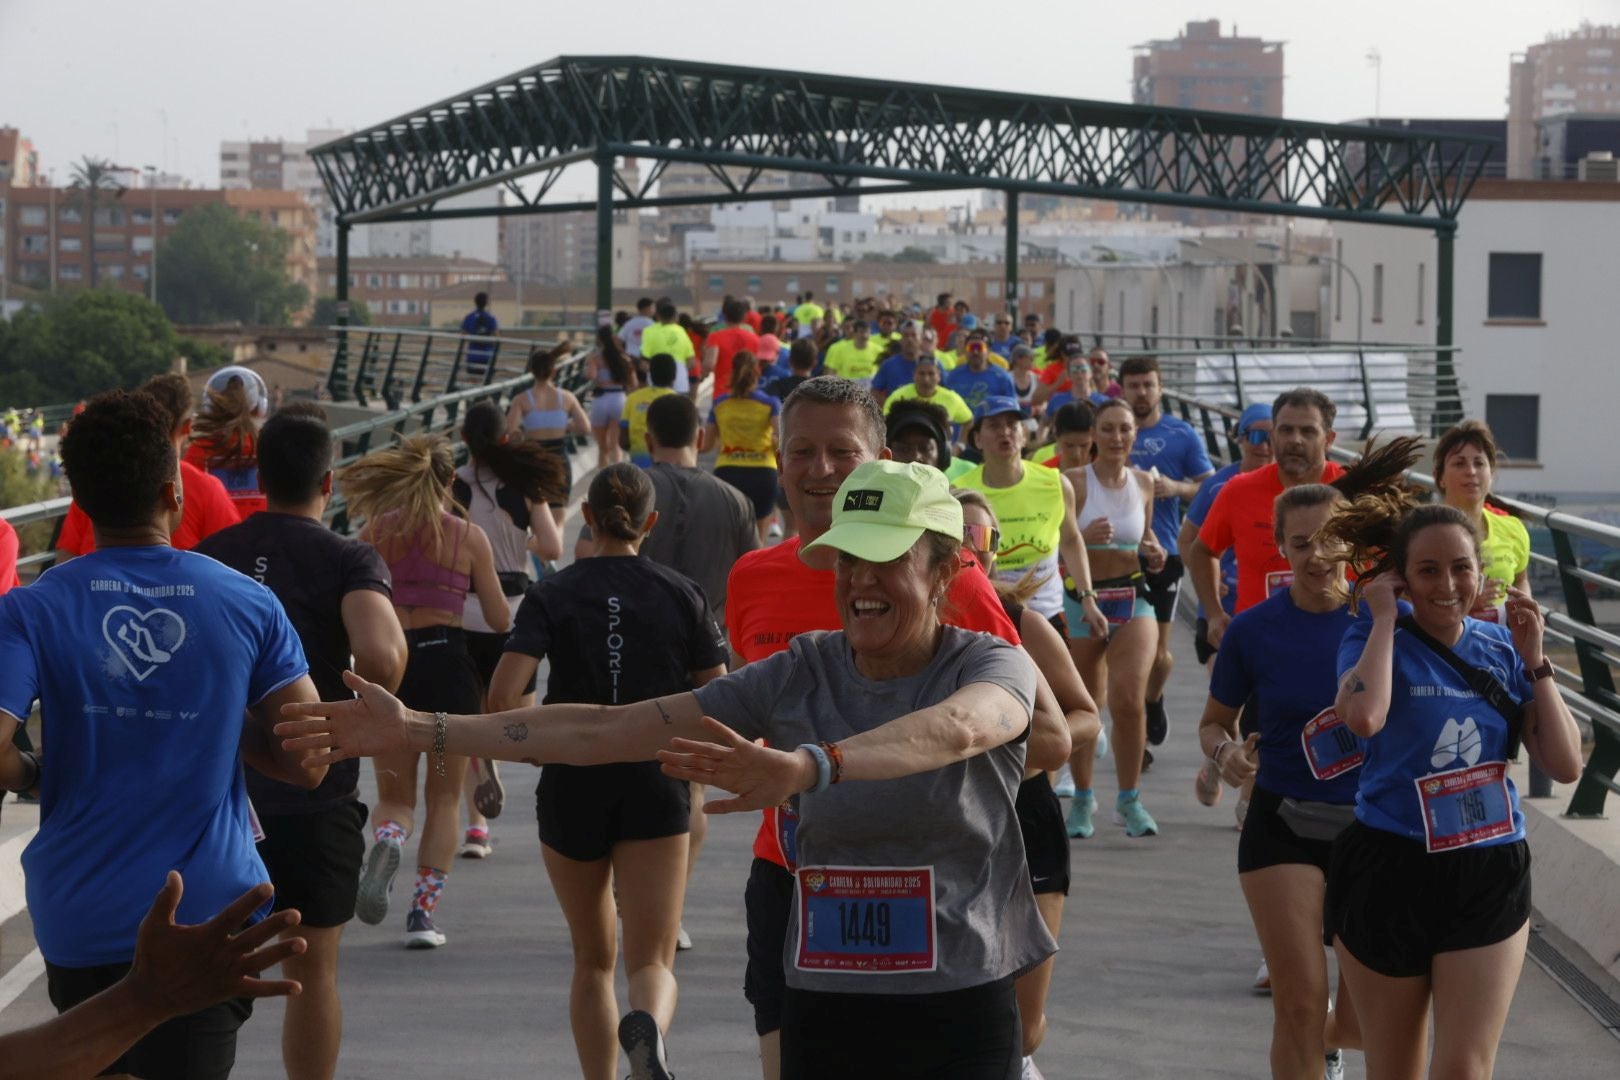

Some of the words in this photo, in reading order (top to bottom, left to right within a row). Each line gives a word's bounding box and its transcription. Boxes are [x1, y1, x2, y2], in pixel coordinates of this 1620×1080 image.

[90, 579, 121, 592] CARRERA
[176, 585, 195, 597] 2025
[1409, 686, 1434, 697] CARRERA
[829, 875, 853, 888] CARRERA
[863, 875, 902, 888] SOLIDARIDAD
[904, 874, 921, 887] 2025
[837, 902, 890, 946] 1449
